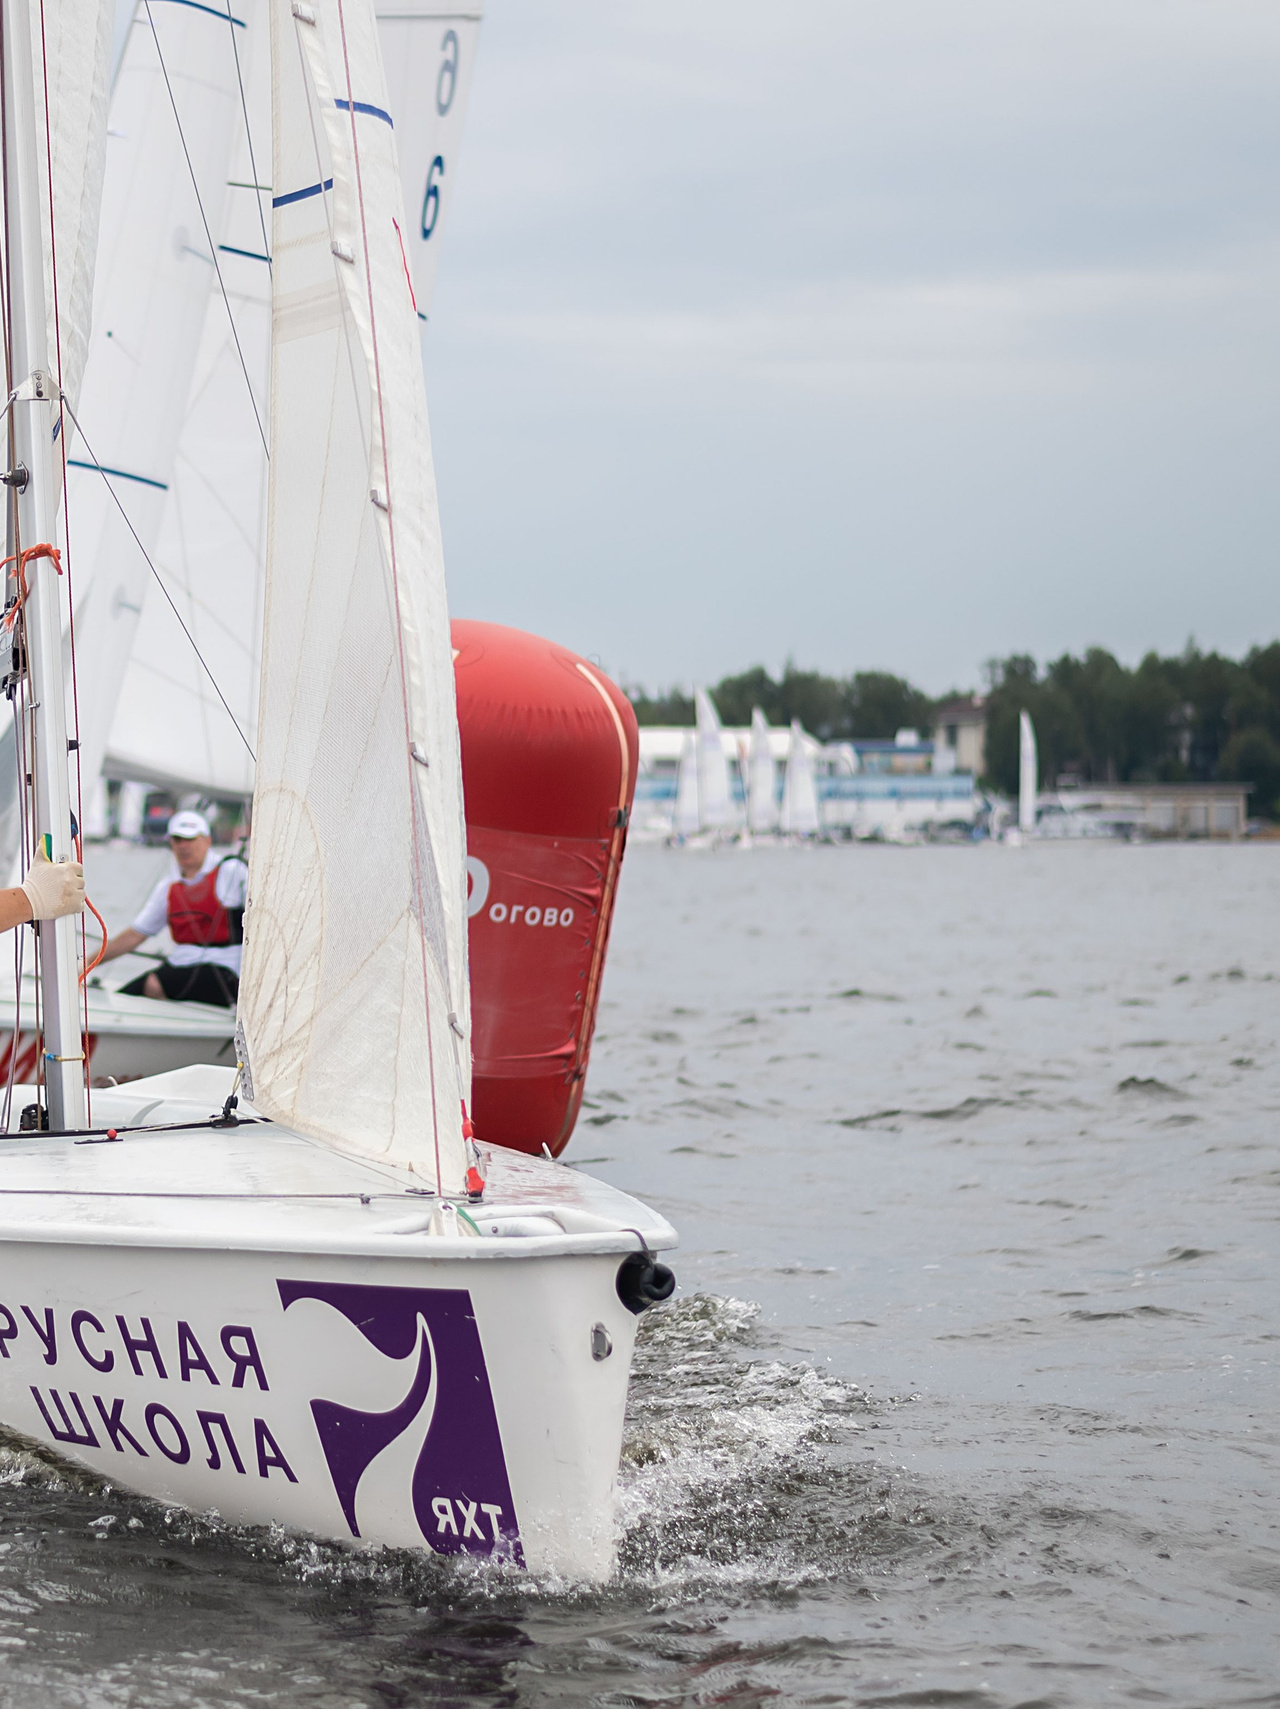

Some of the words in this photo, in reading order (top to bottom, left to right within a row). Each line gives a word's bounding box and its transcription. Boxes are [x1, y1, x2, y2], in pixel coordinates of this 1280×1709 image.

[422, 155, 444, 241] 6
[29, 1385, 299, 1483] ШКОЛА
[431, 1497, 503, 1541] ЯХТ
